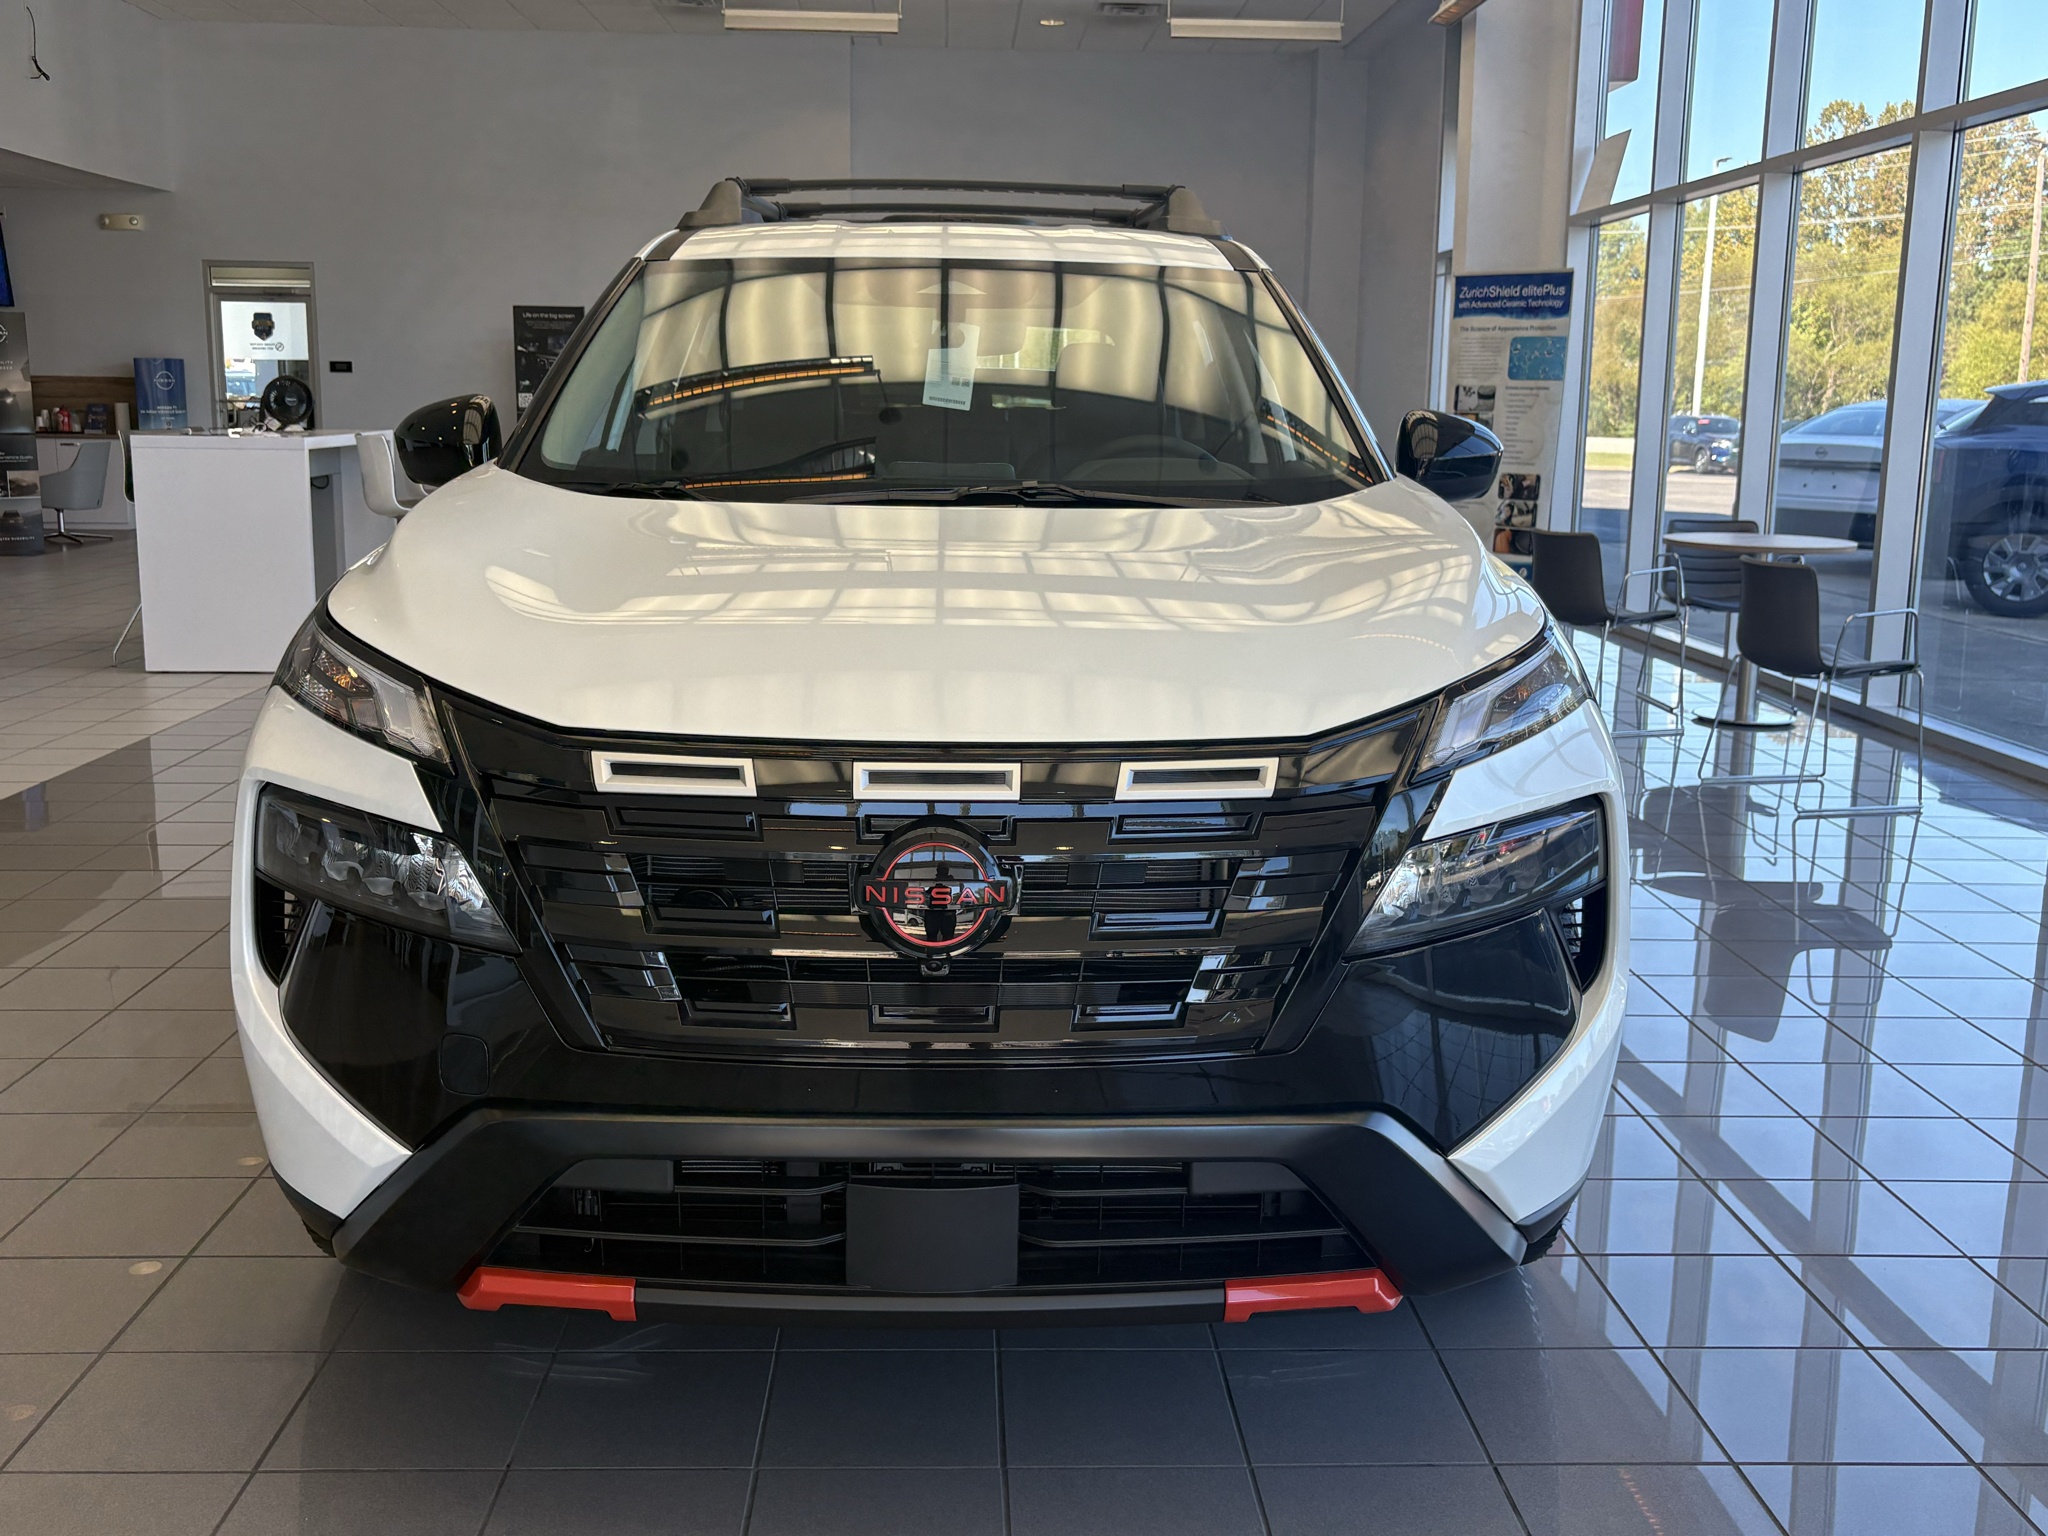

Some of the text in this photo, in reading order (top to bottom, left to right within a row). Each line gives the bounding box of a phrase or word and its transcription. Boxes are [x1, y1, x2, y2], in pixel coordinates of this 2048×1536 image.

[1459, 284, 1566, 299] ZurichShield elitePlus
[1459, 299, 1564, 309] with Advanced Ceramic Technology
[549, 312, 558, 320] big
[865, 885, 1006, 905] NISSAN
